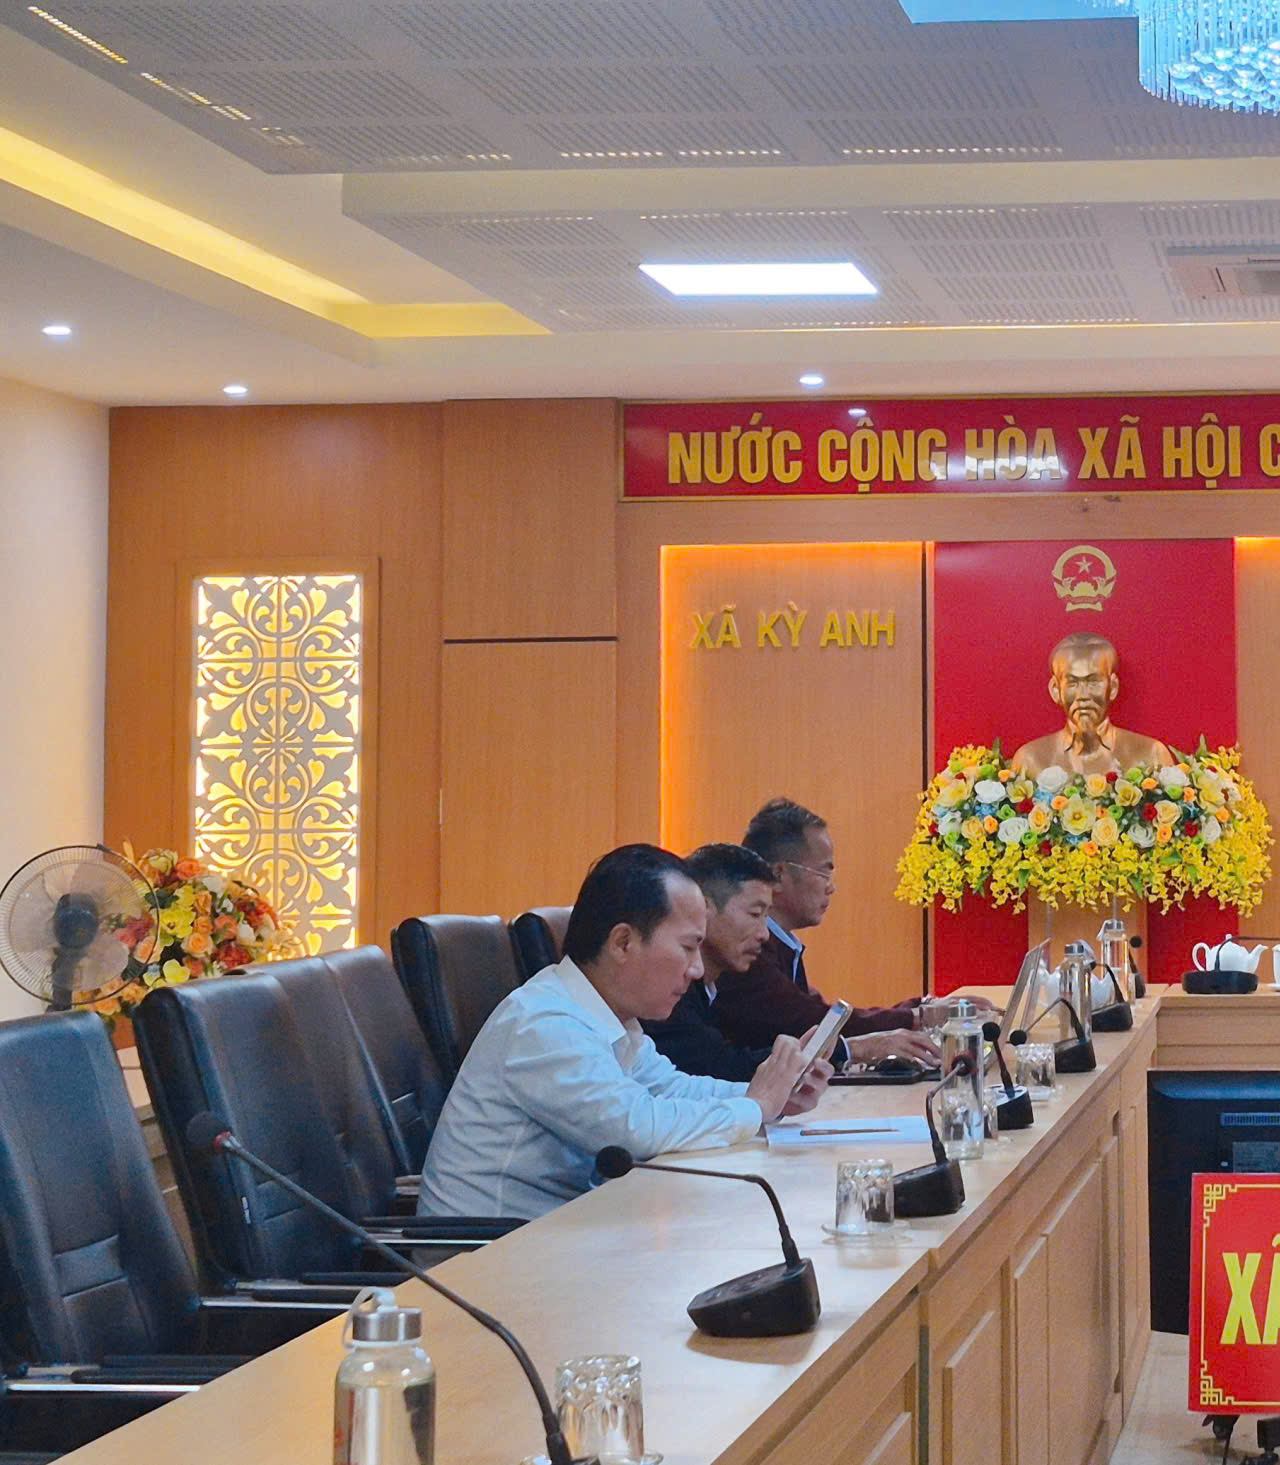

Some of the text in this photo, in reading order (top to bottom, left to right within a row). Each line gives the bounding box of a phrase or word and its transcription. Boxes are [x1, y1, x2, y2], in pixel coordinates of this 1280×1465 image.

[667, 411, 802, 484] NƯỚC
[818, 416, 948, 492] CỘNG
[964, 414, 1063, 482] HÒA
[1077, 415, 1147, 480] XÃ
[1162, 412, 1243, 489] HỘI
[689, 601, 896, 648] XÃ KỲ ANH
